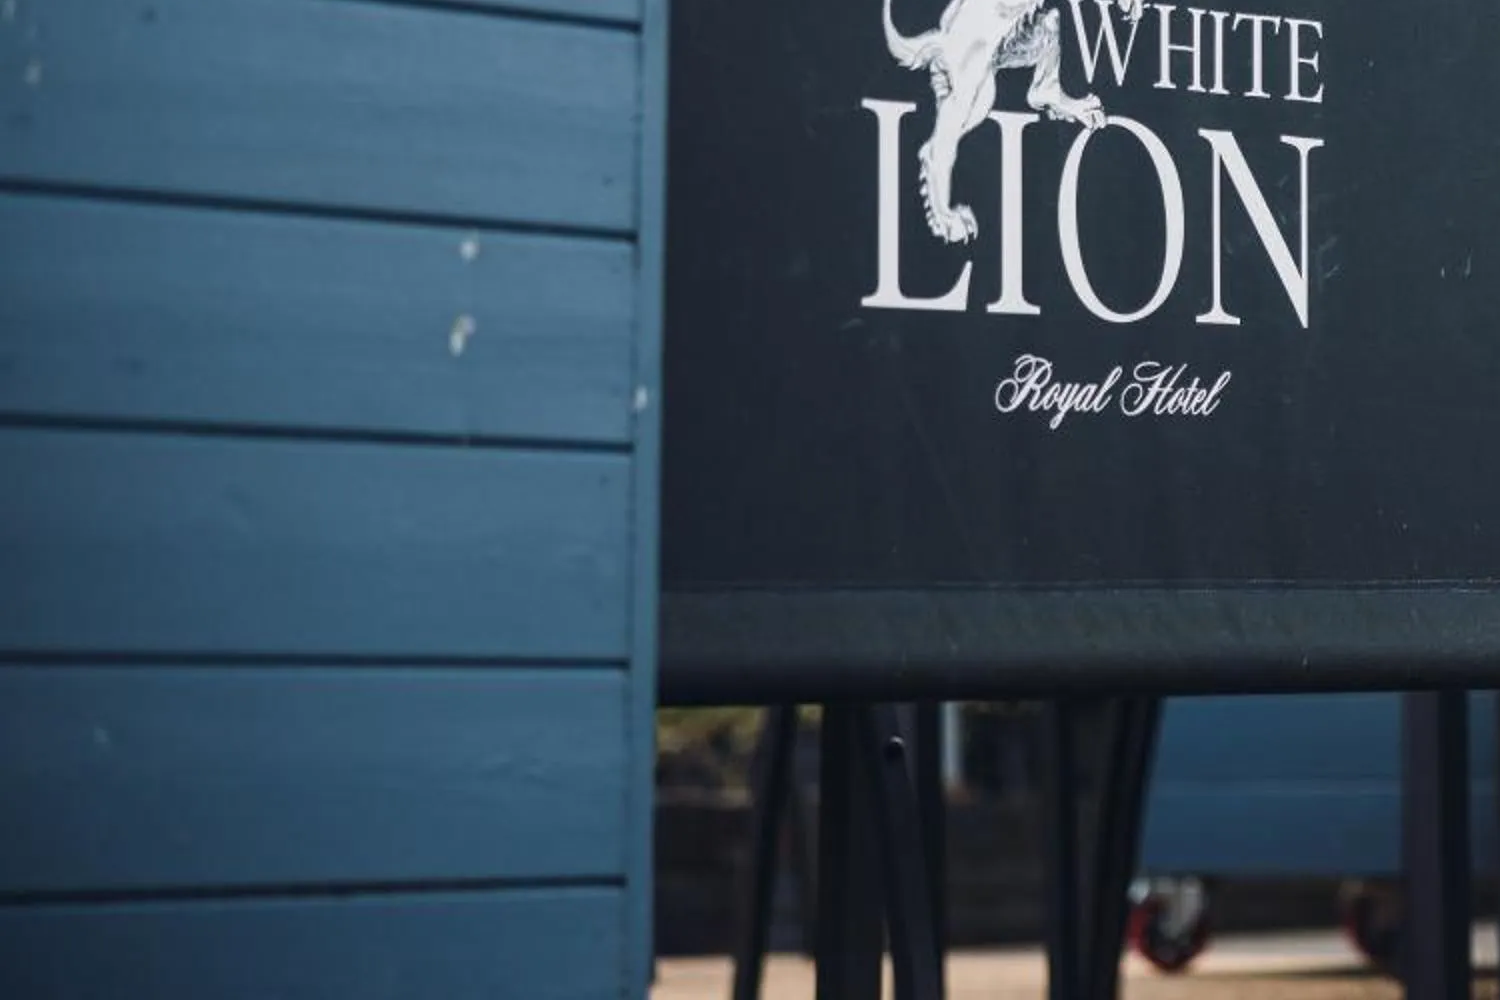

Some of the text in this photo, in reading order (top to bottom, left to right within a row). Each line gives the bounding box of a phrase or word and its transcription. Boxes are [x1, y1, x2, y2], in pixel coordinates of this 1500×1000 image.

[860, 97, 1325, 329] LION
[994, 353, 1232, 430] Royal Hotel
